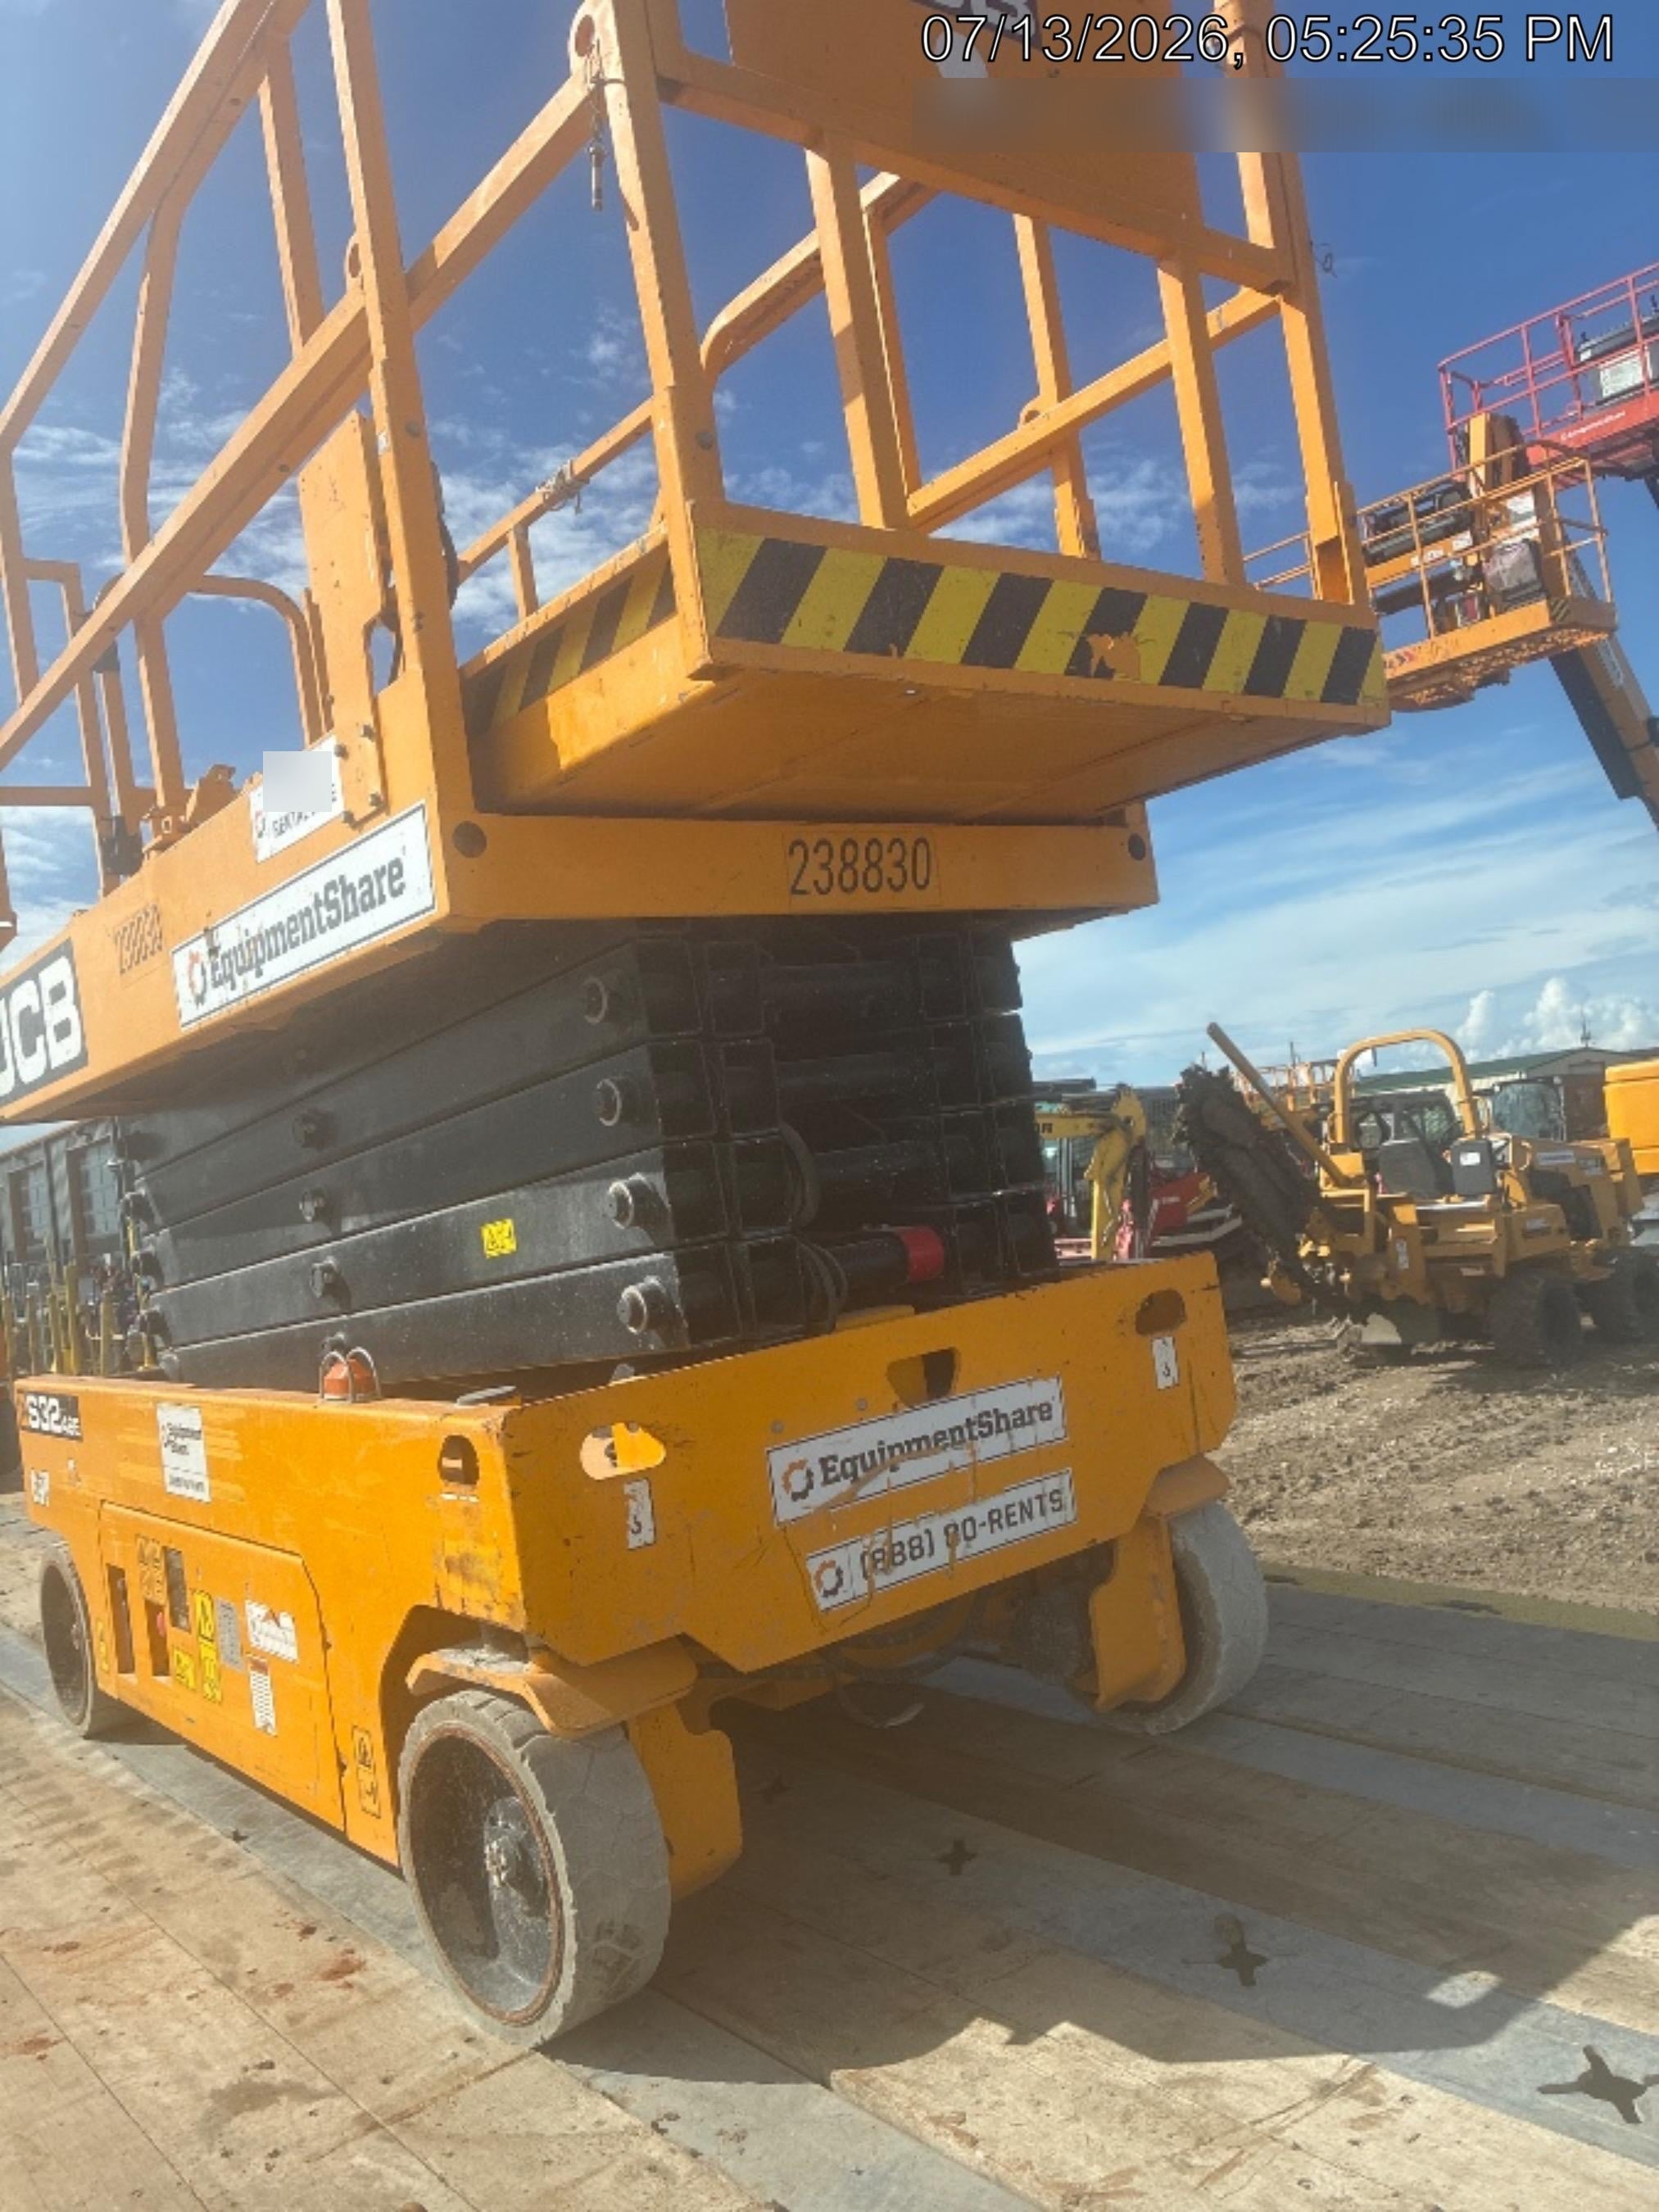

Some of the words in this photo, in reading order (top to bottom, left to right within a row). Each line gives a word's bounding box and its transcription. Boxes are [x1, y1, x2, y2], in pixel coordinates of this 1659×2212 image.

[789, 837, 931, 895] 238830
[210, 857, 406, 991] EquipmentShare
[819, 1401, 1054, 1486] EquipmentShare
